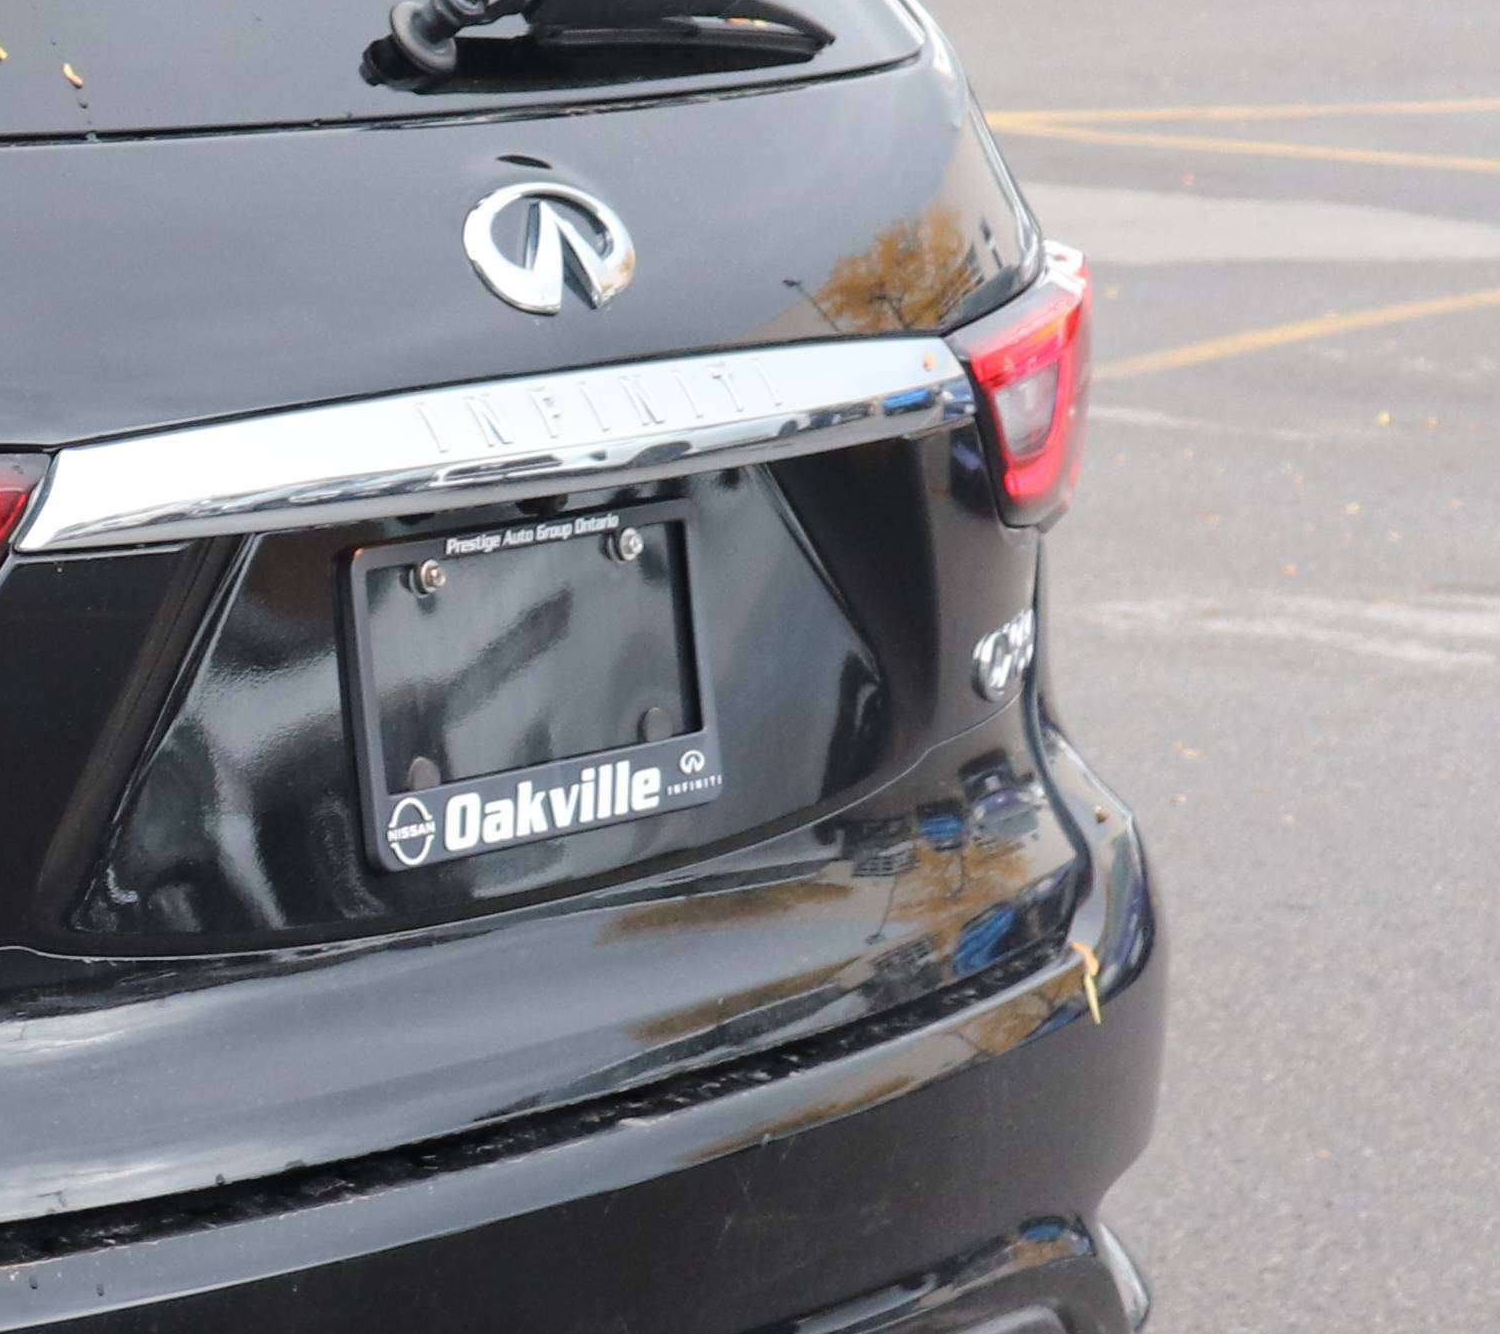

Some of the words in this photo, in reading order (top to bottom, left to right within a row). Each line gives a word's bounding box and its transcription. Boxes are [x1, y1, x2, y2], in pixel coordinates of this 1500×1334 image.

[415, 358, 785, 453] INFINITI
[445, 534, 500, 556] Prestige
[502, 528, 534, 547] Auto
[535, 521, 573, 541] Group
[574, 513, 620, 534] Ontario
[443, 760, 662, 851] Oakville
[666, 774, 723, 796] INFINITI
[387, 820, 436, 842] NISSAN
